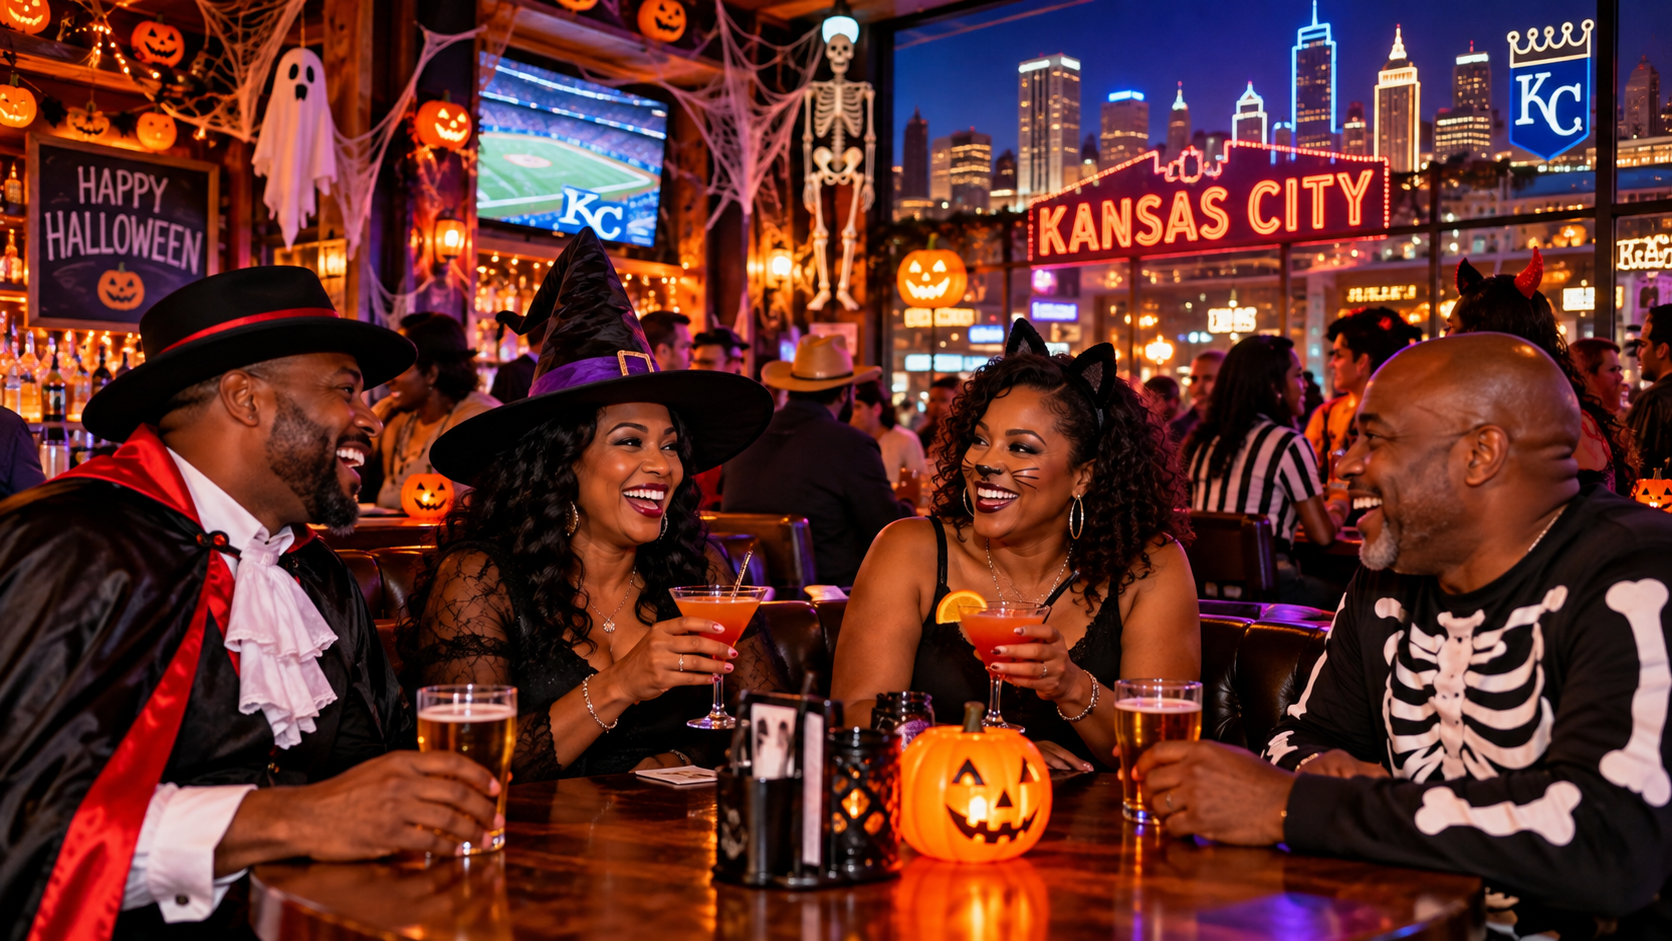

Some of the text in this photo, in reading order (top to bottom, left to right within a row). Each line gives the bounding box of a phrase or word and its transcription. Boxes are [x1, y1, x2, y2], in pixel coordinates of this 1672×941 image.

[1515, 72, 1582, 136] KC
[78, 165, 169, 214] HAPPY
[558, 187, 624, 240] KC
[1038, 168, 1374, 257] KANSAS CITY
[45, 210, 203, 275] HALLOWEEN
